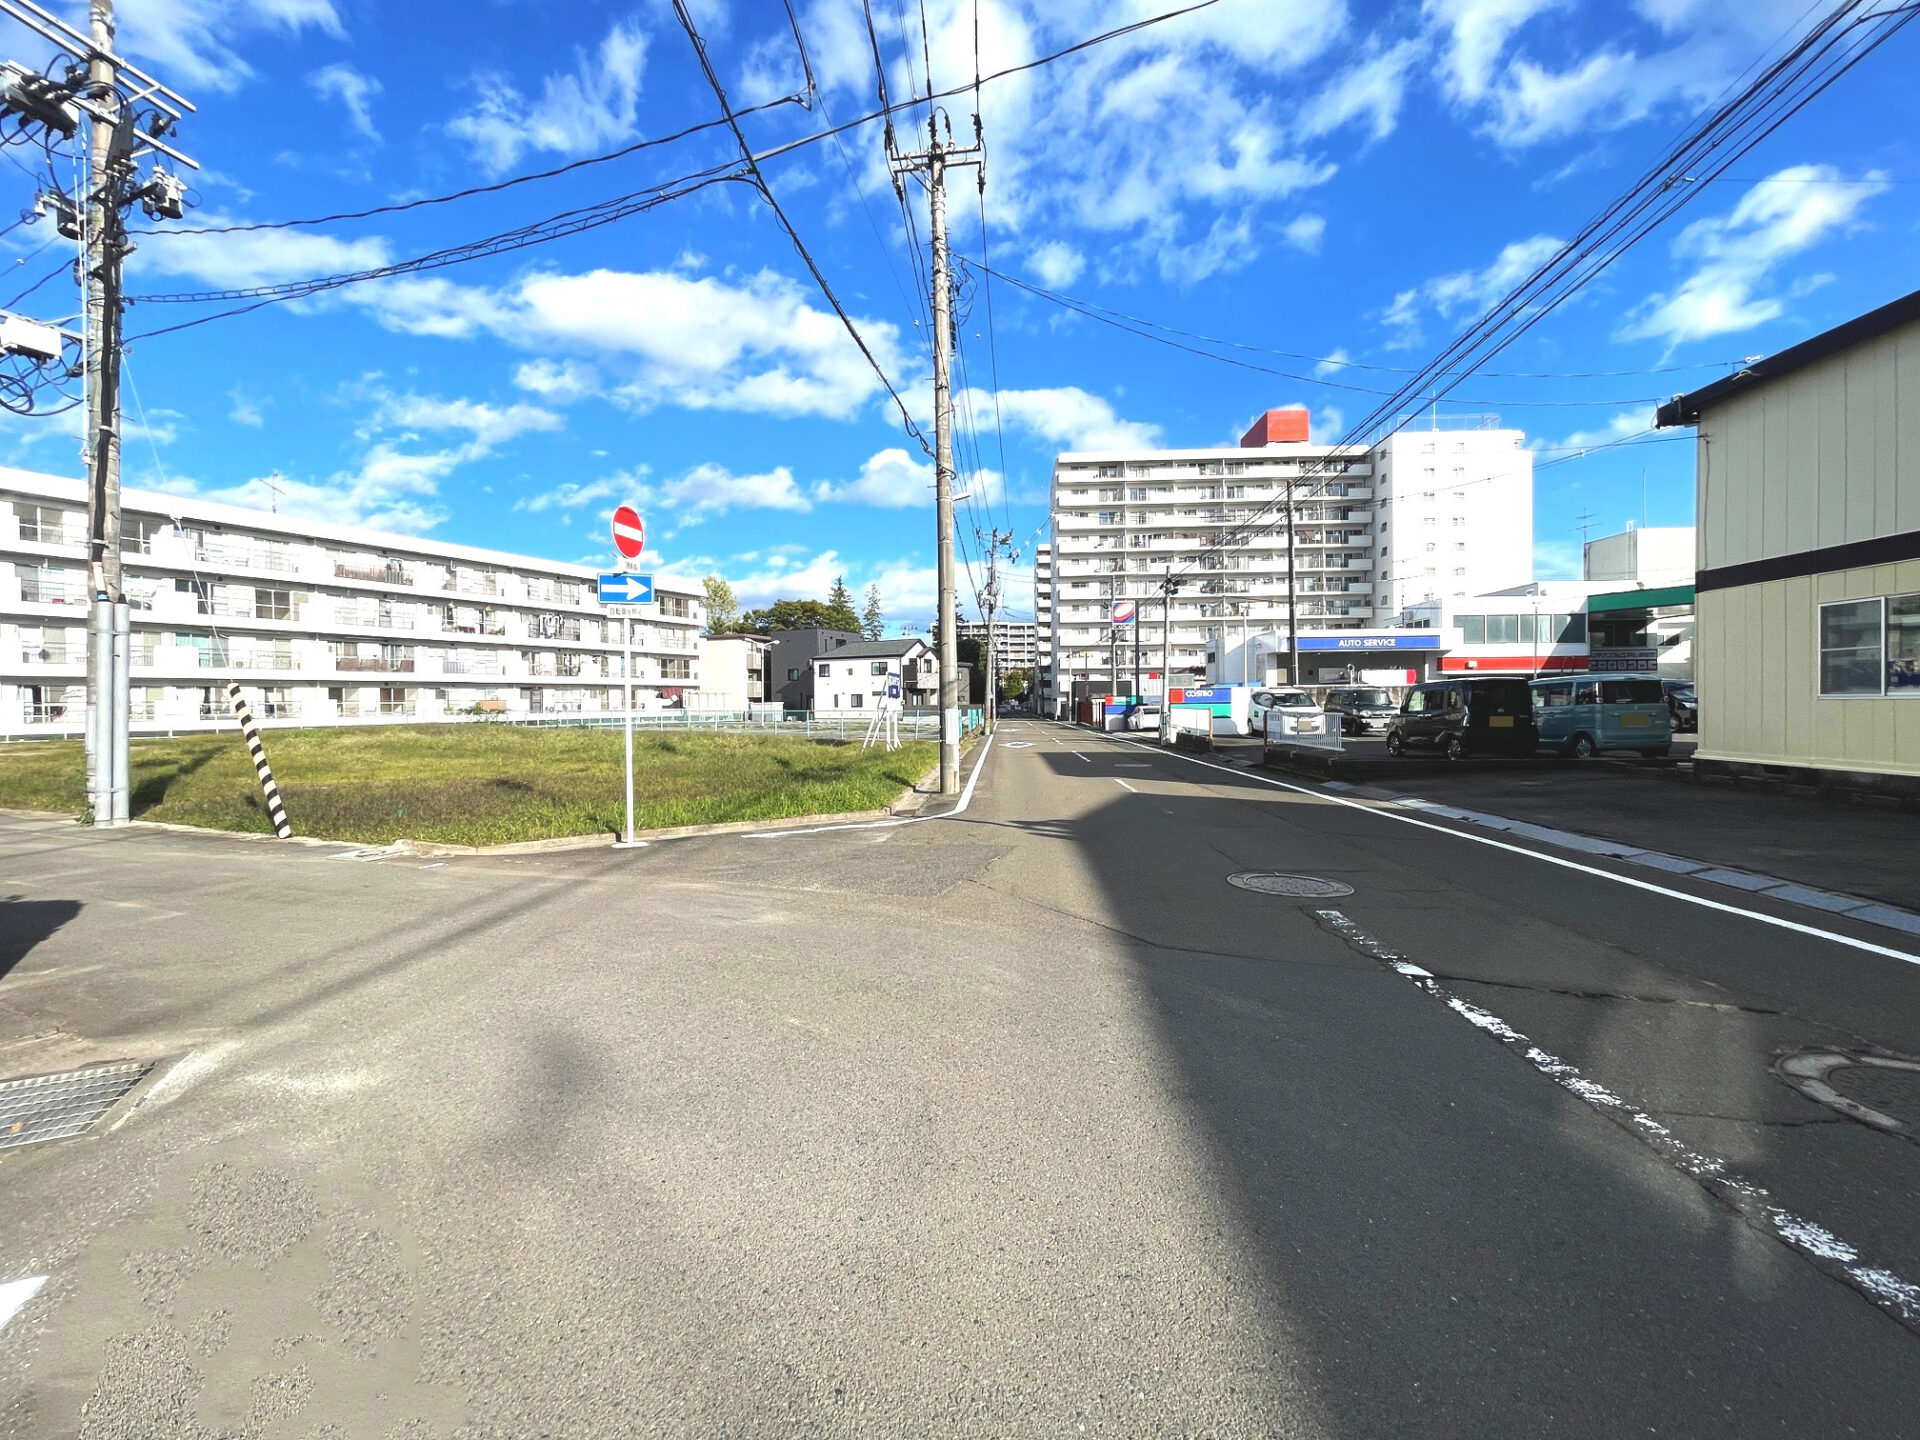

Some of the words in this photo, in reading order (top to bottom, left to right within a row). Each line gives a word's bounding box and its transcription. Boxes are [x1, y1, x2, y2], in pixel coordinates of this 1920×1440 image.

[1338, 640, 1362, 648] AUTO
[1363, 639, 1397, 647] SERVICE
[1185, 690, 1213, 698] COSMO
